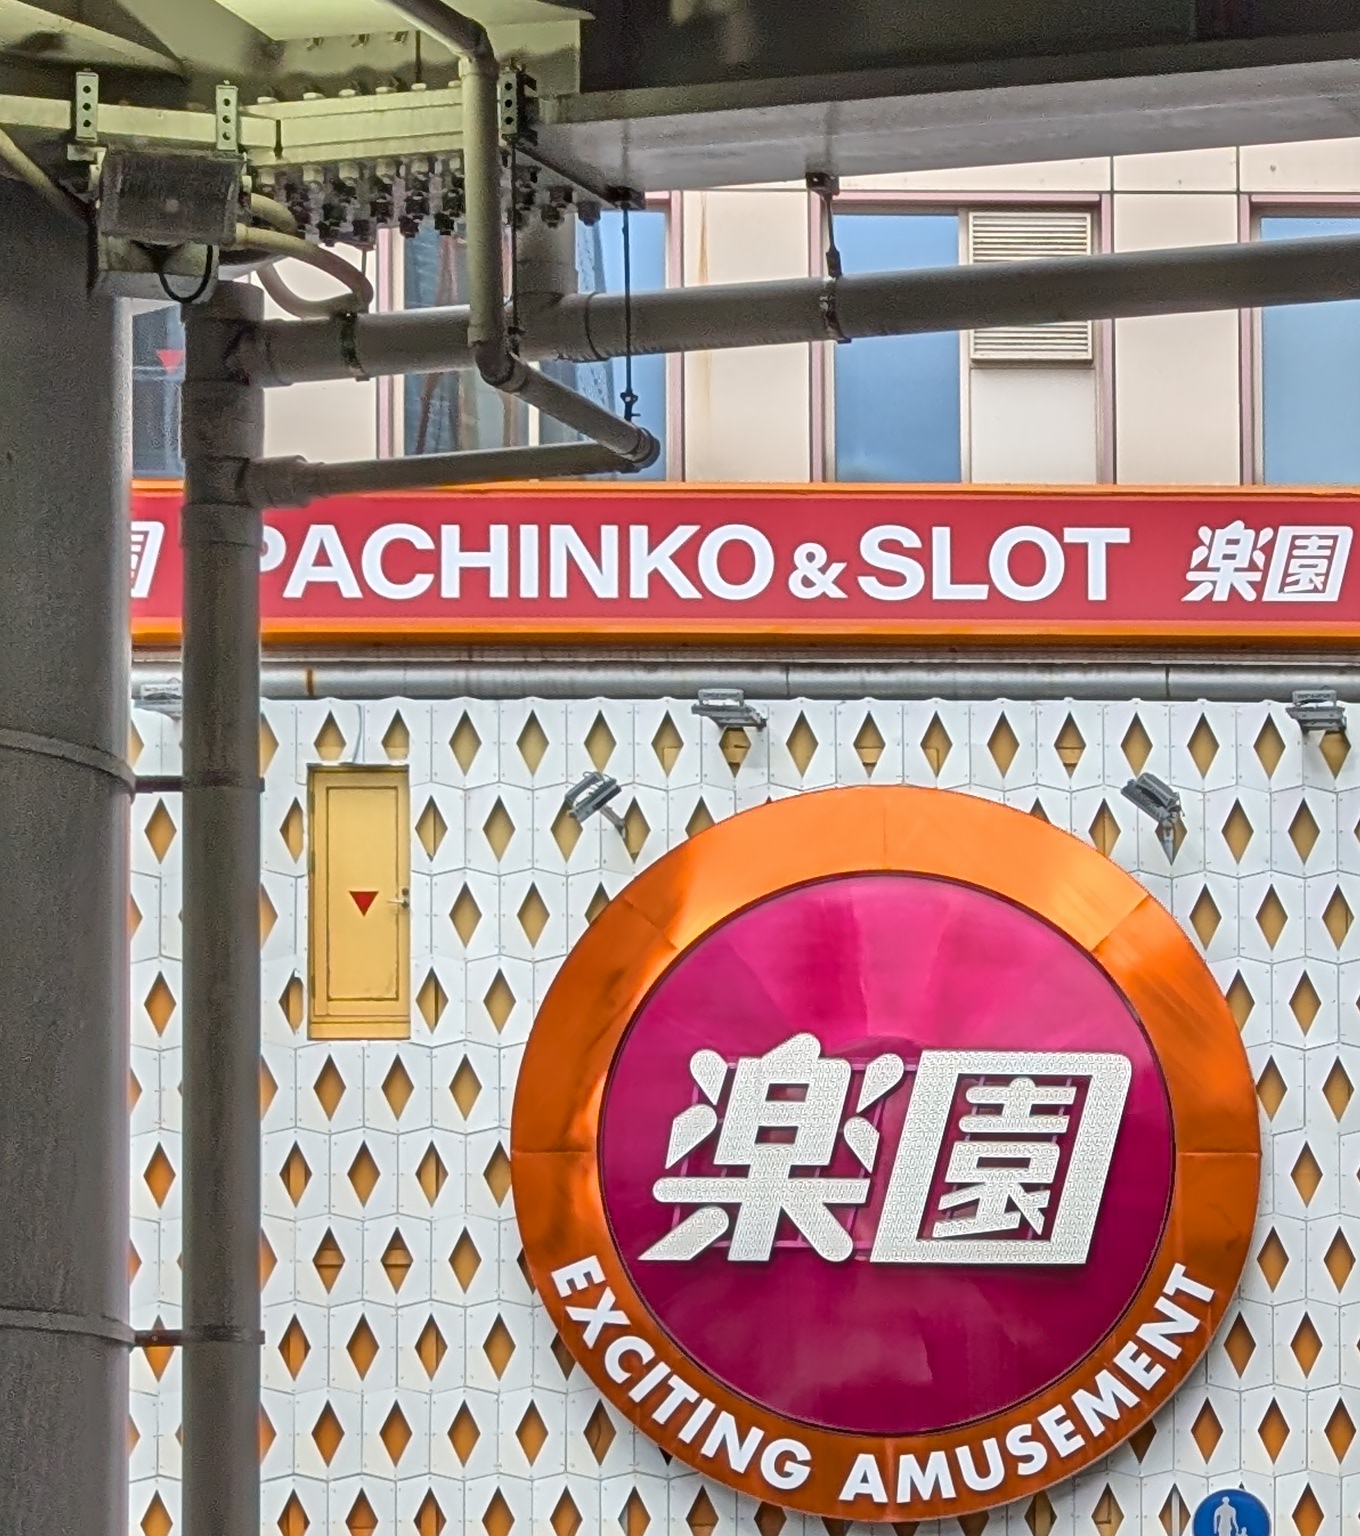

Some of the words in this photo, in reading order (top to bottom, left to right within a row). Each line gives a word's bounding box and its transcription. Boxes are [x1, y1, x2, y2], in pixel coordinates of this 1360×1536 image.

[1181, 519, 1355, 602] 楽園
[637, 1031, 1133, 1265] 楽園
[551, 1255, 812, 1491] EXCITING
[838, 1262, 1216, 1505] AMUSEMENT
